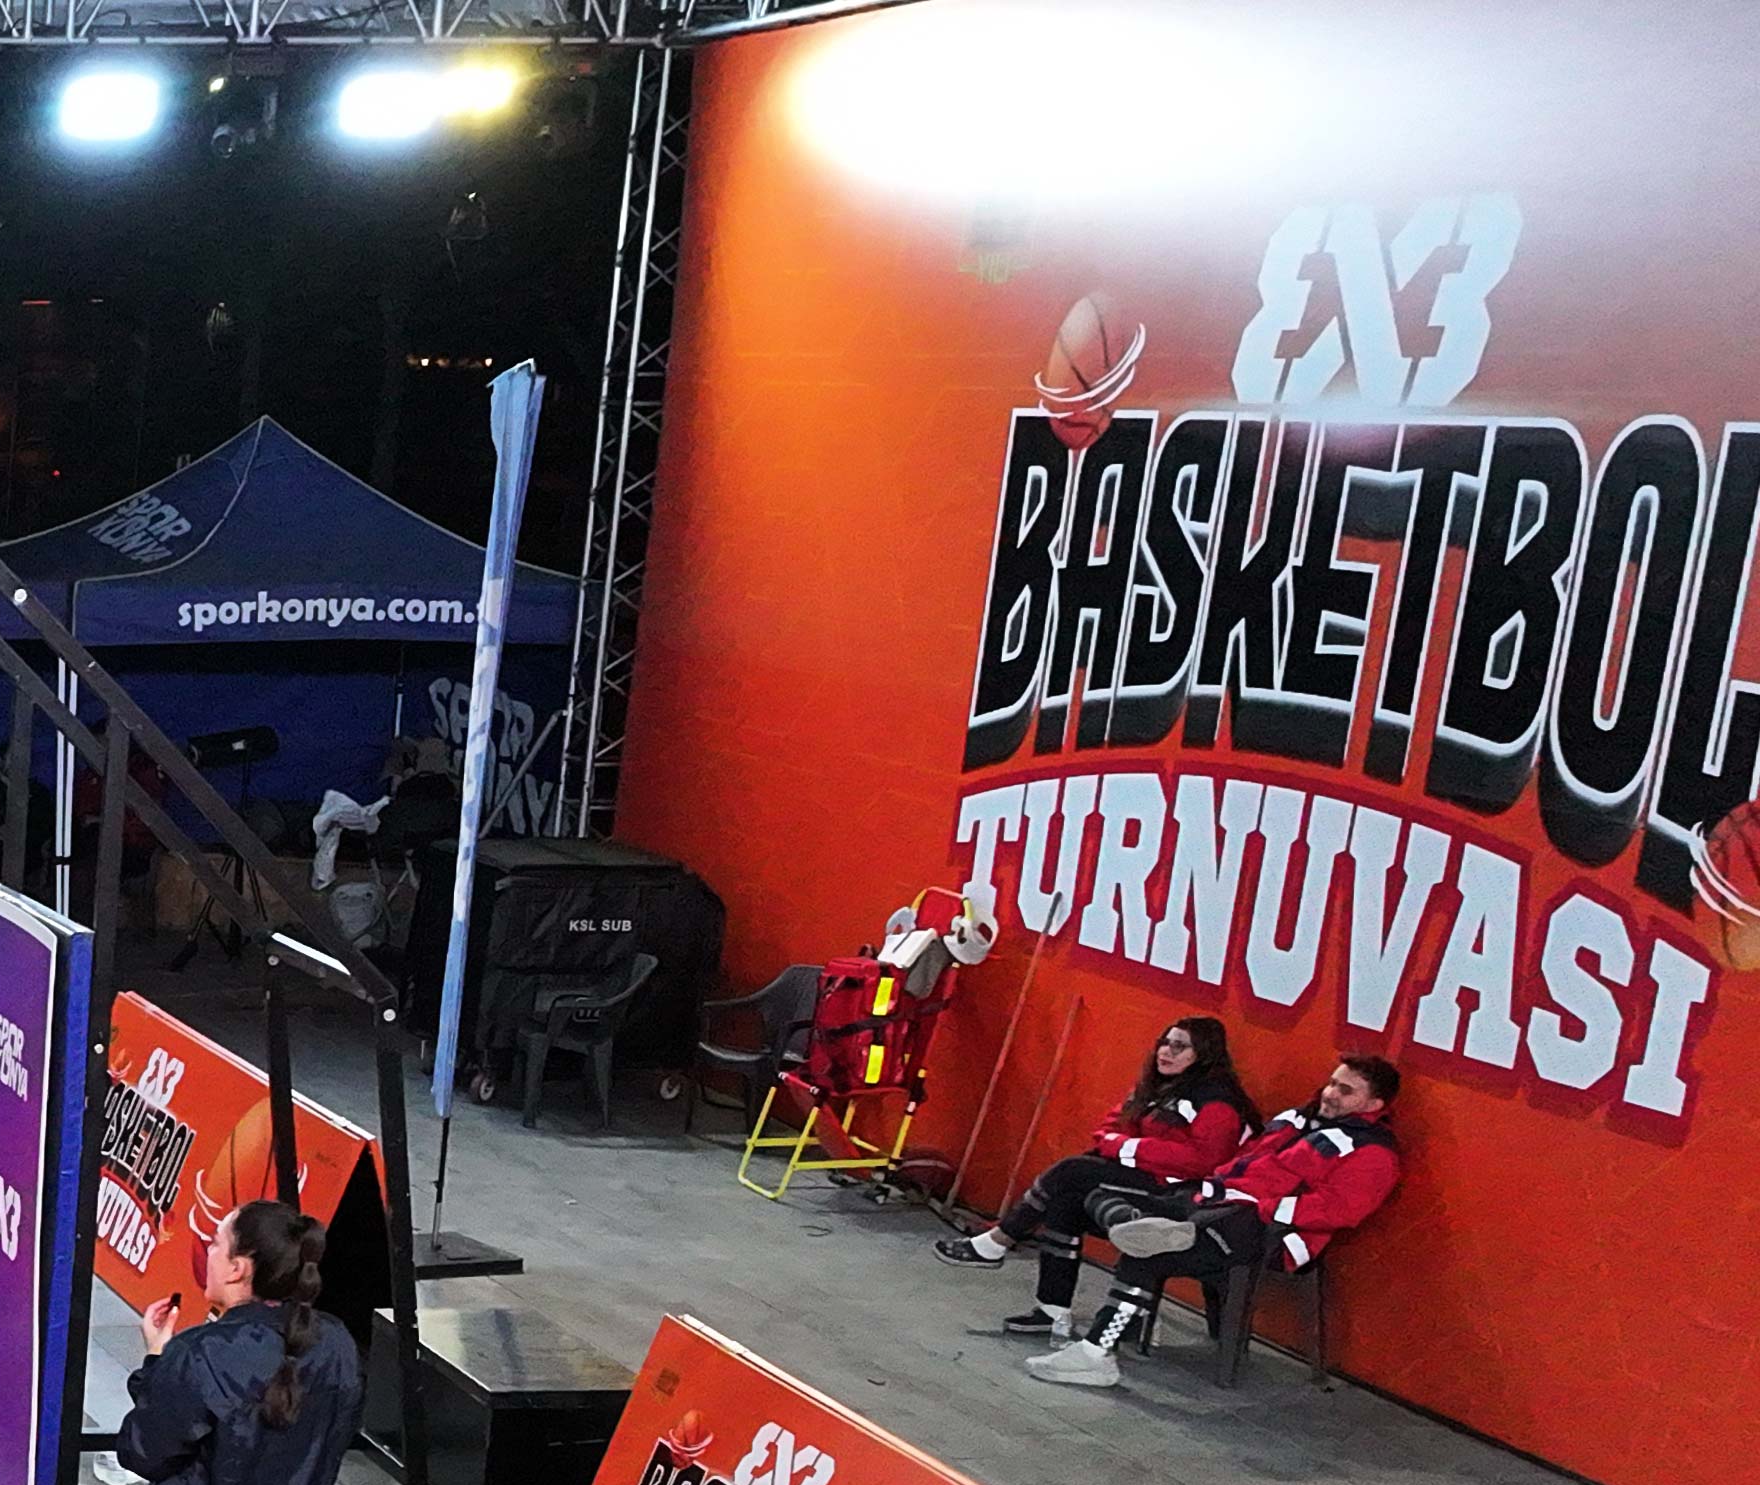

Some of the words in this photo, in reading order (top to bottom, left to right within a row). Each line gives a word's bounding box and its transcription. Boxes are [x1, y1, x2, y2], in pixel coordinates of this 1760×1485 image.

[966, 408, 1760, 855] BASKETBOL
[569, 919, 596, 932] KSL
[601, 919, 632, 932] SUB
[957, 770, 1711, 1118] TURNUVASI
